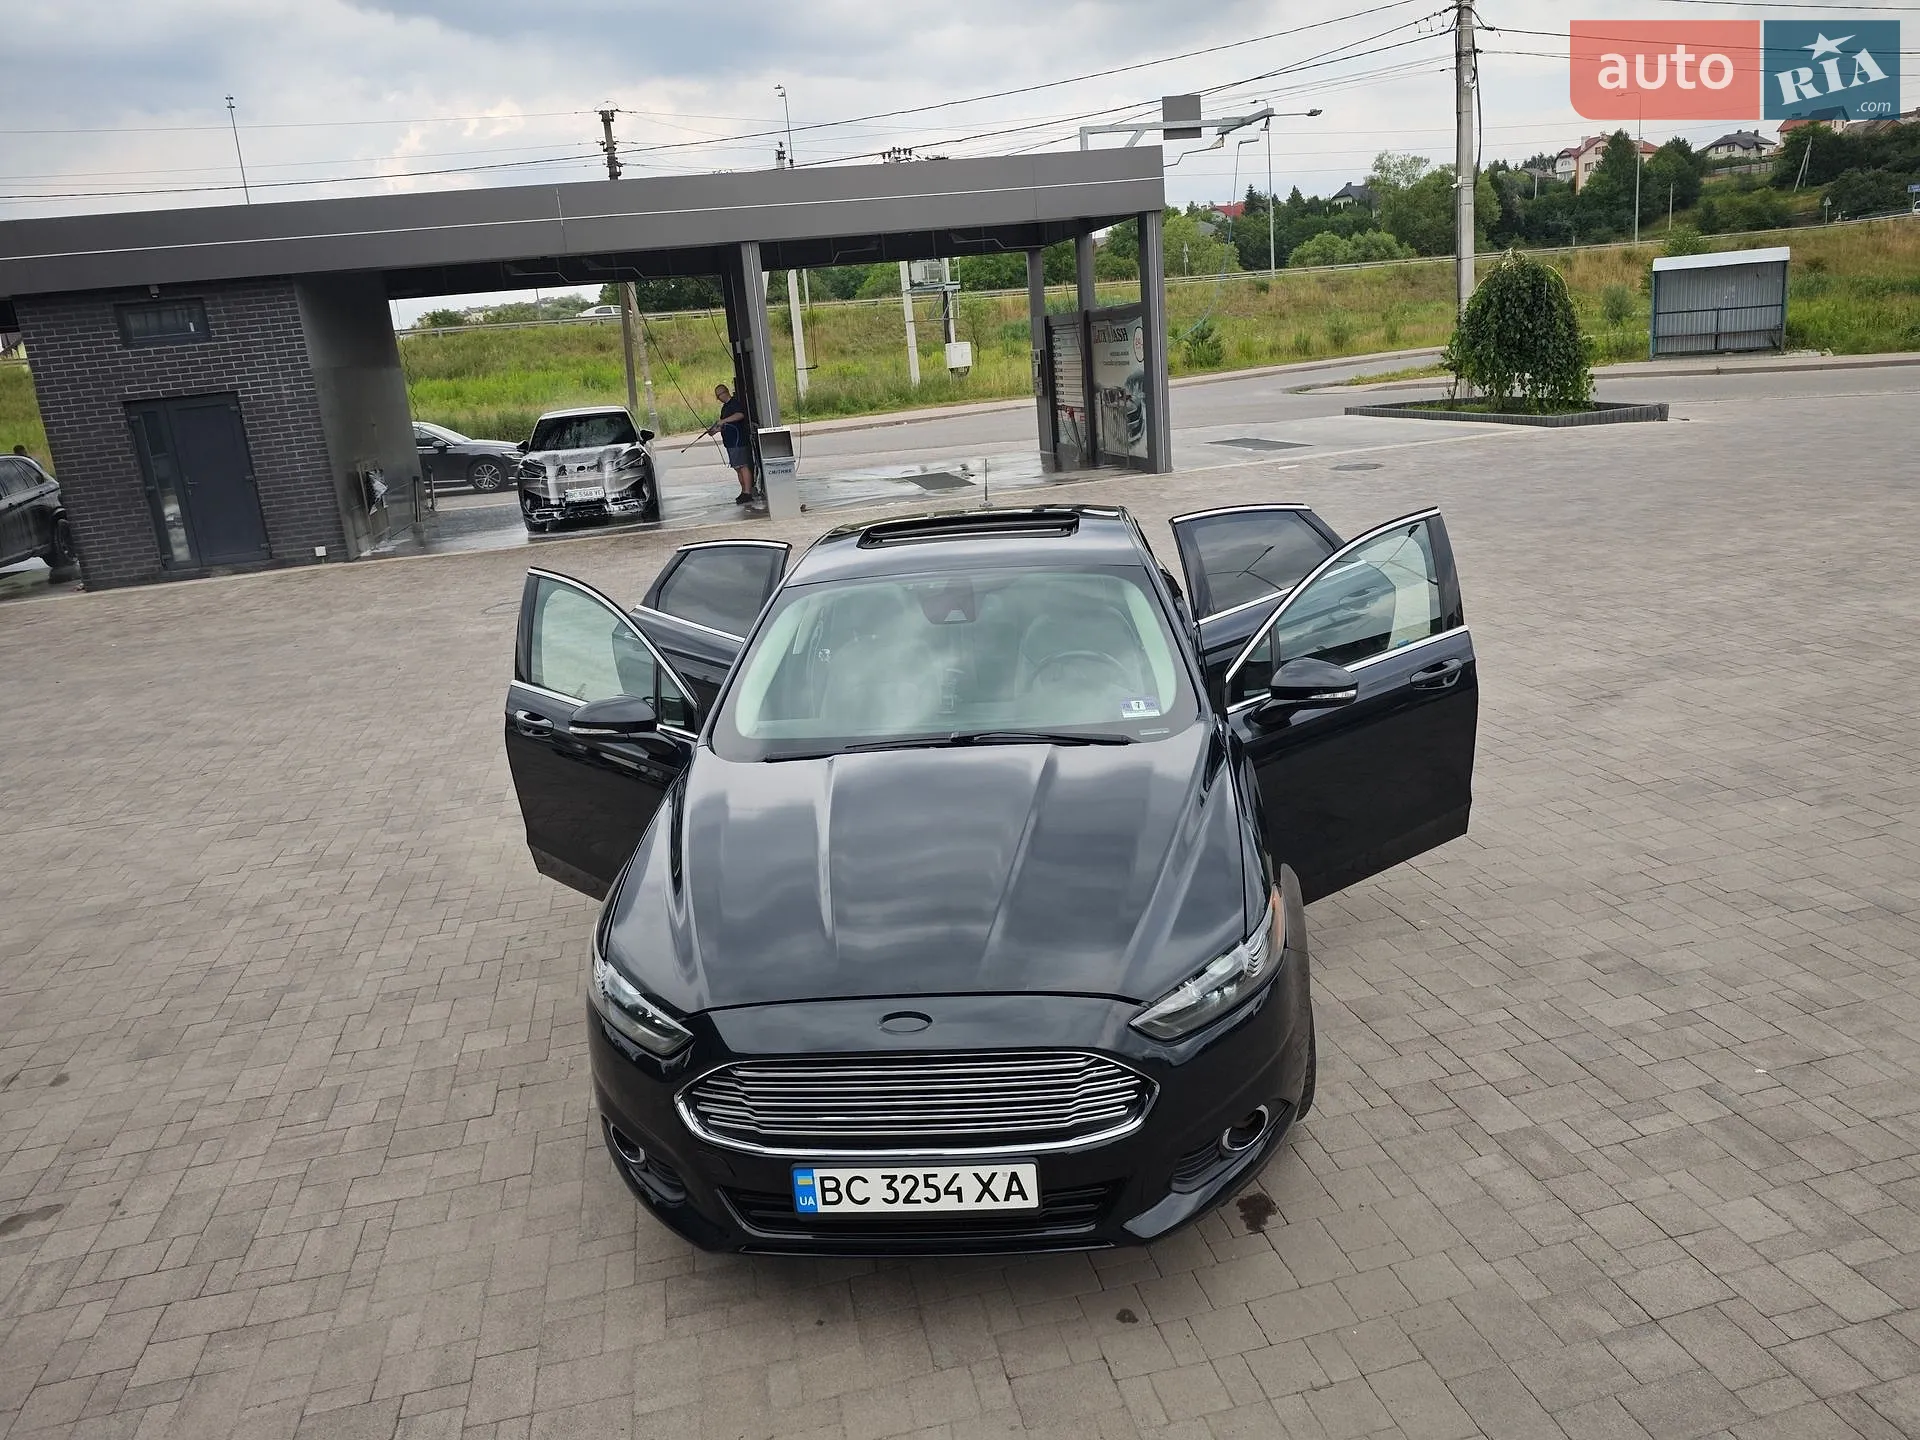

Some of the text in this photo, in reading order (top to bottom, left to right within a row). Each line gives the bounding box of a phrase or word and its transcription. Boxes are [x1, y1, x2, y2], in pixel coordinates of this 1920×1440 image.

[819, 1171, 1029, 1206] BC 3254 XA
[800, 1196, 816, 1207] UA
